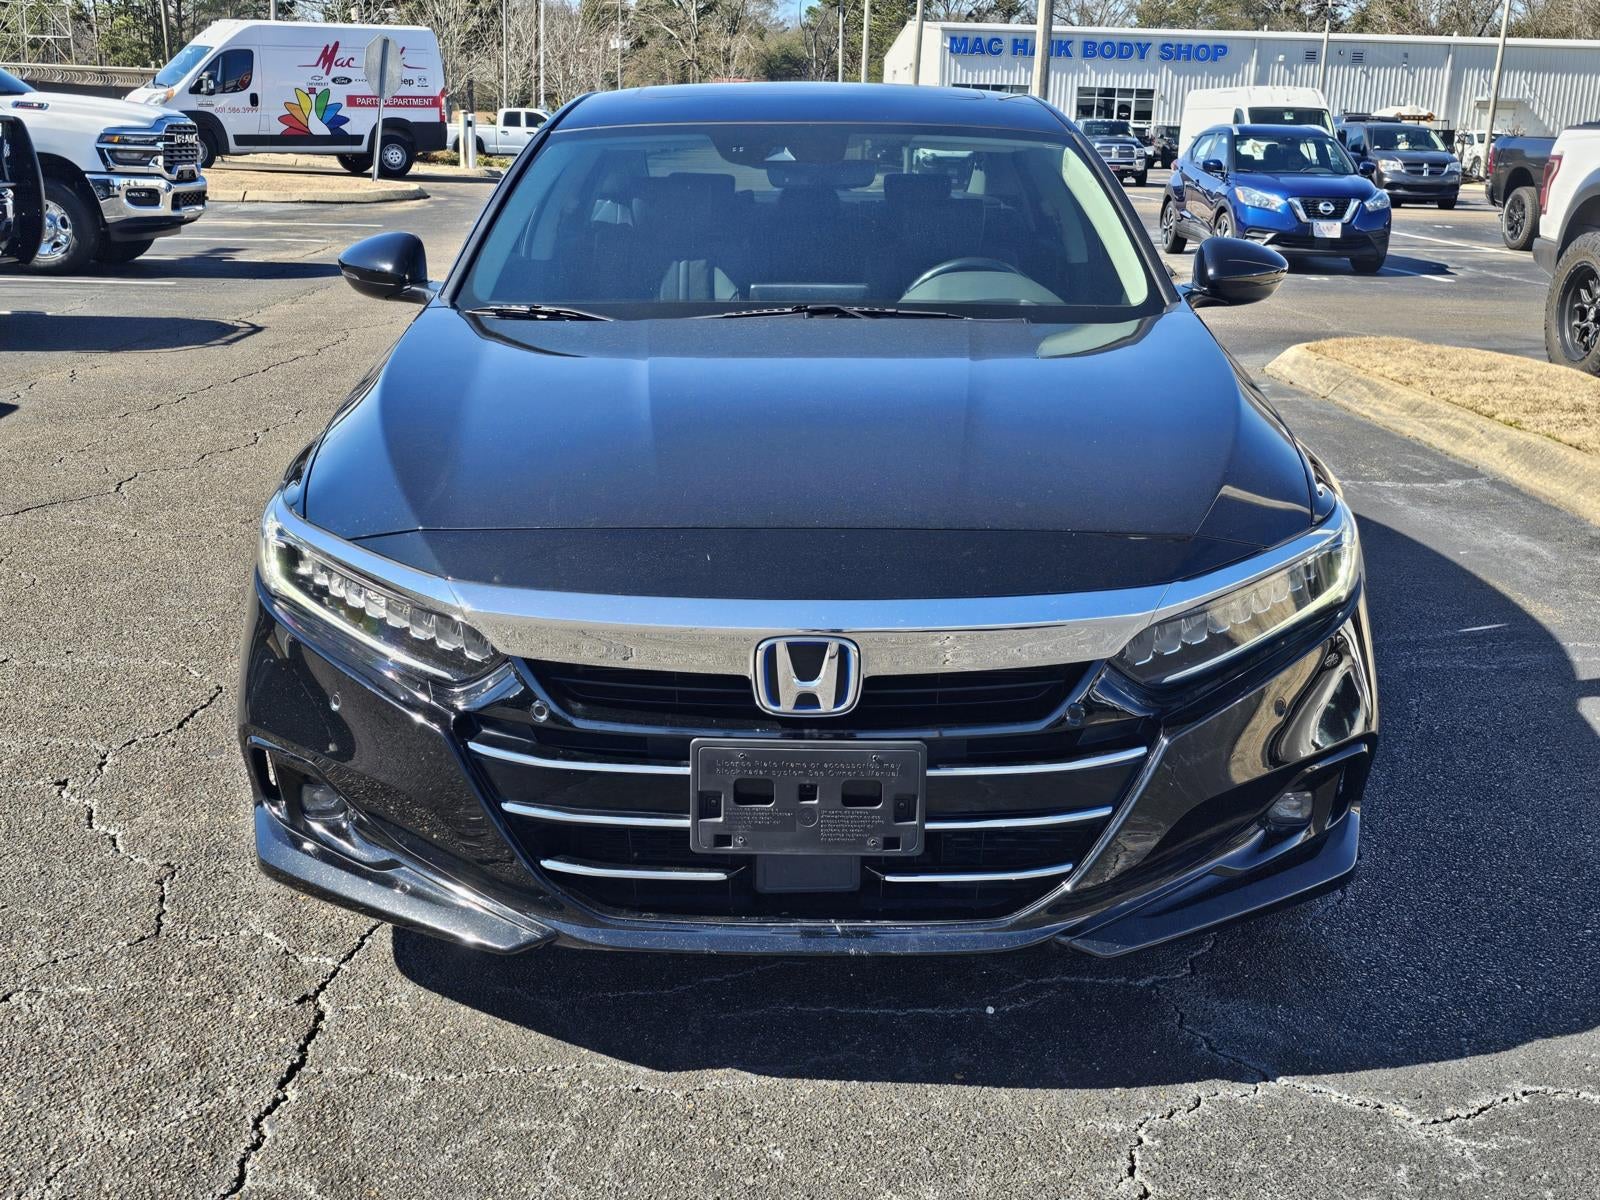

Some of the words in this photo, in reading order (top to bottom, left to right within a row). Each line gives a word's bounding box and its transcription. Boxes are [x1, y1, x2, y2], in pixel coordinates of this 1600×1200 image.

[949, 36, 1004, 56] MAC
[1012, 38, 1073, 58] HIK
[1082, 40, 1151, 60] BODY
[1159, 42, 1229, 63] SHOP
[314, 40, 355, 76] Mac
[356, 97, 381, 106] PARTS
[383, 98, 433, 106] DEPARTMENT
[176, 134, 197, 144] RAM
[883, 763, 901, 771] may
